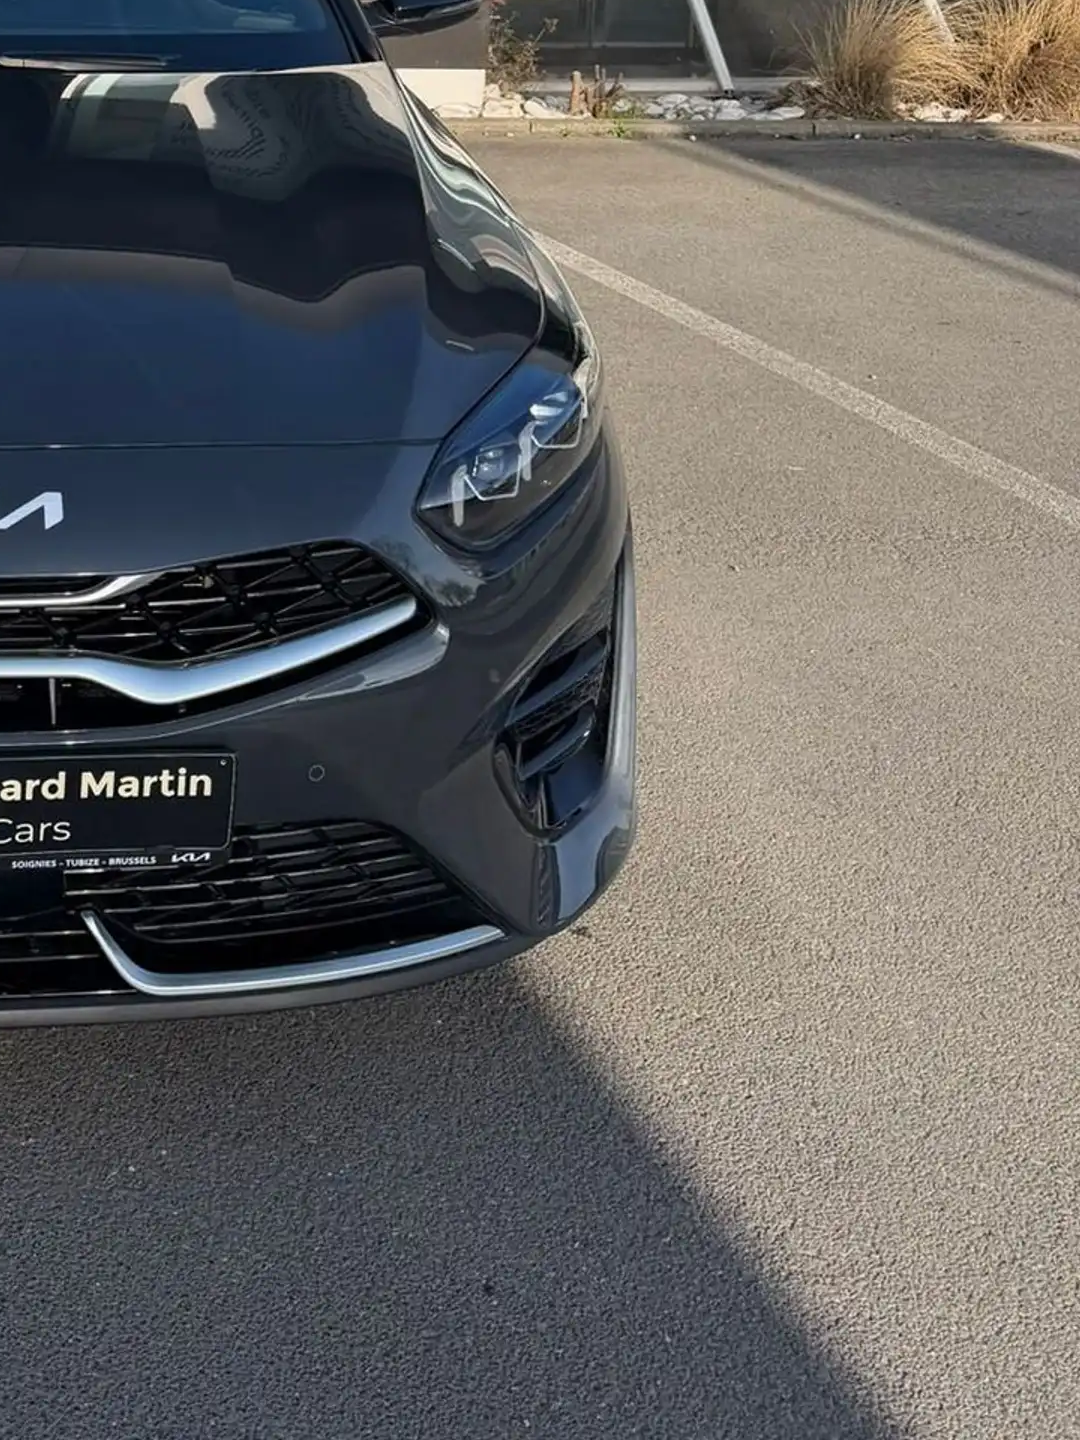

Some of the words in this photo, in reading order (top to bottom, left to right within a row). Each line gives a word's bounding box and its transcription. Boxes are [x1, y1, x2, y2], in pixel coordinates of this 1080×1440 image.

[80, 767, 213, 799] Martin
[11, 860, 57, 870] SOIGNIES
[66, 858, 100, 868] TUBIZE
[109, 856, 157, 867] BRUSSELS
